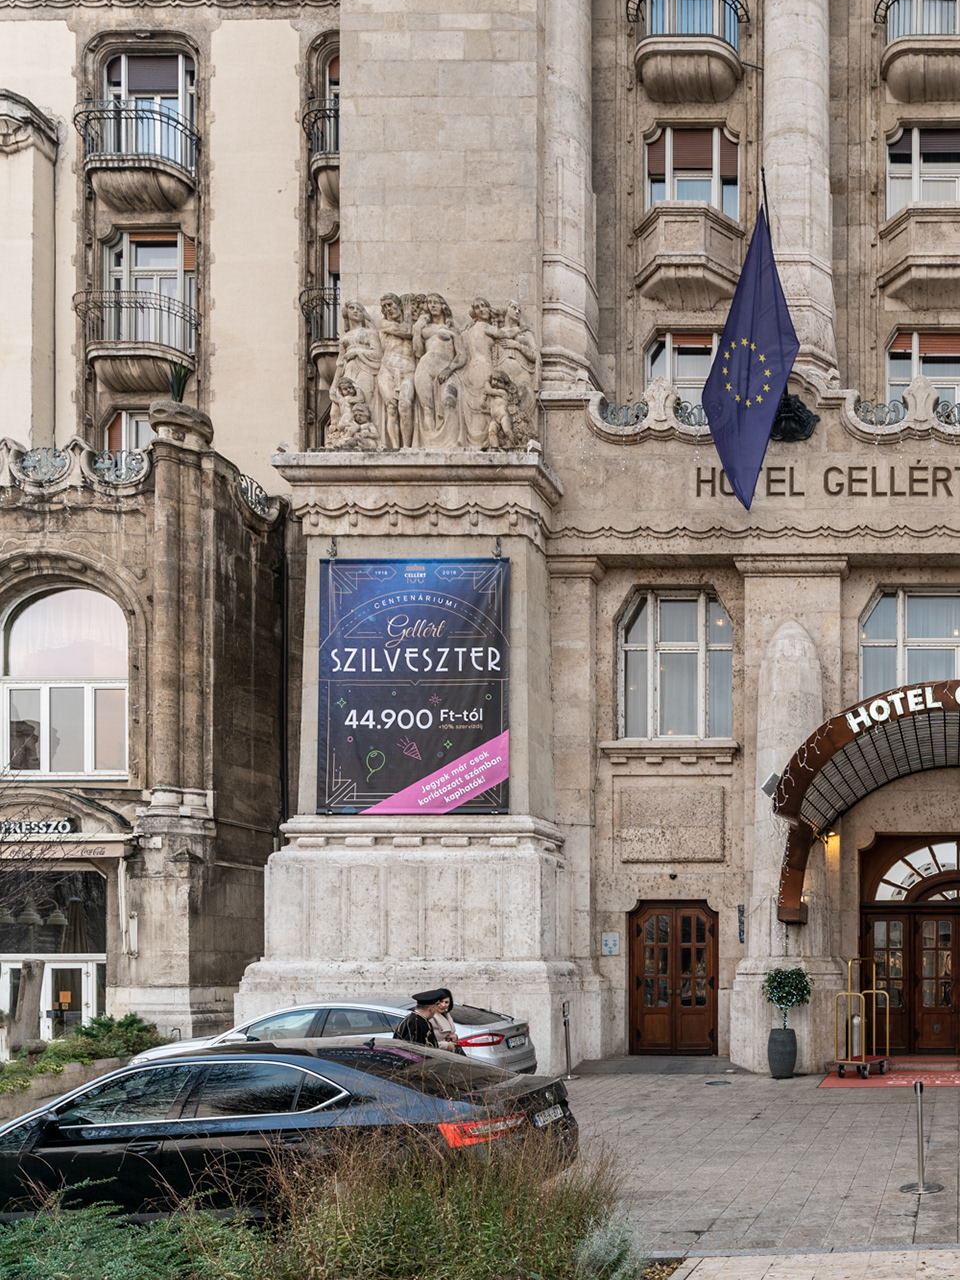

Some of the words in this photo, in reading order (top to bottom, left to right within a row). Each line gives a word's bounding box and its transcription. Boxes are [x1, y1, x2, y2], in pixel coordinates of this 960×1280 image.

[695, 466, 805, 498] HOEL
[373, 593, 458, 610] CENTENÁRIUMI
[385, 614, 447, 649] Gellért
[330, 646, 501, 672] SZILVESZTER
[344, 708, 433, 730] 44.900
[440, 708, 484, 722] Ft-tól
[845, 686, 943, 734] HOTEL
[417, 778, 464, 807] korlátozott
[464, 756, 503, 780] számban
[421, 773, 450, 793] Jegyek
[451, 762, 468, 777] már
[469, 751, 490, 766] csak
[443, 775, 486, 803] kaphatók!
